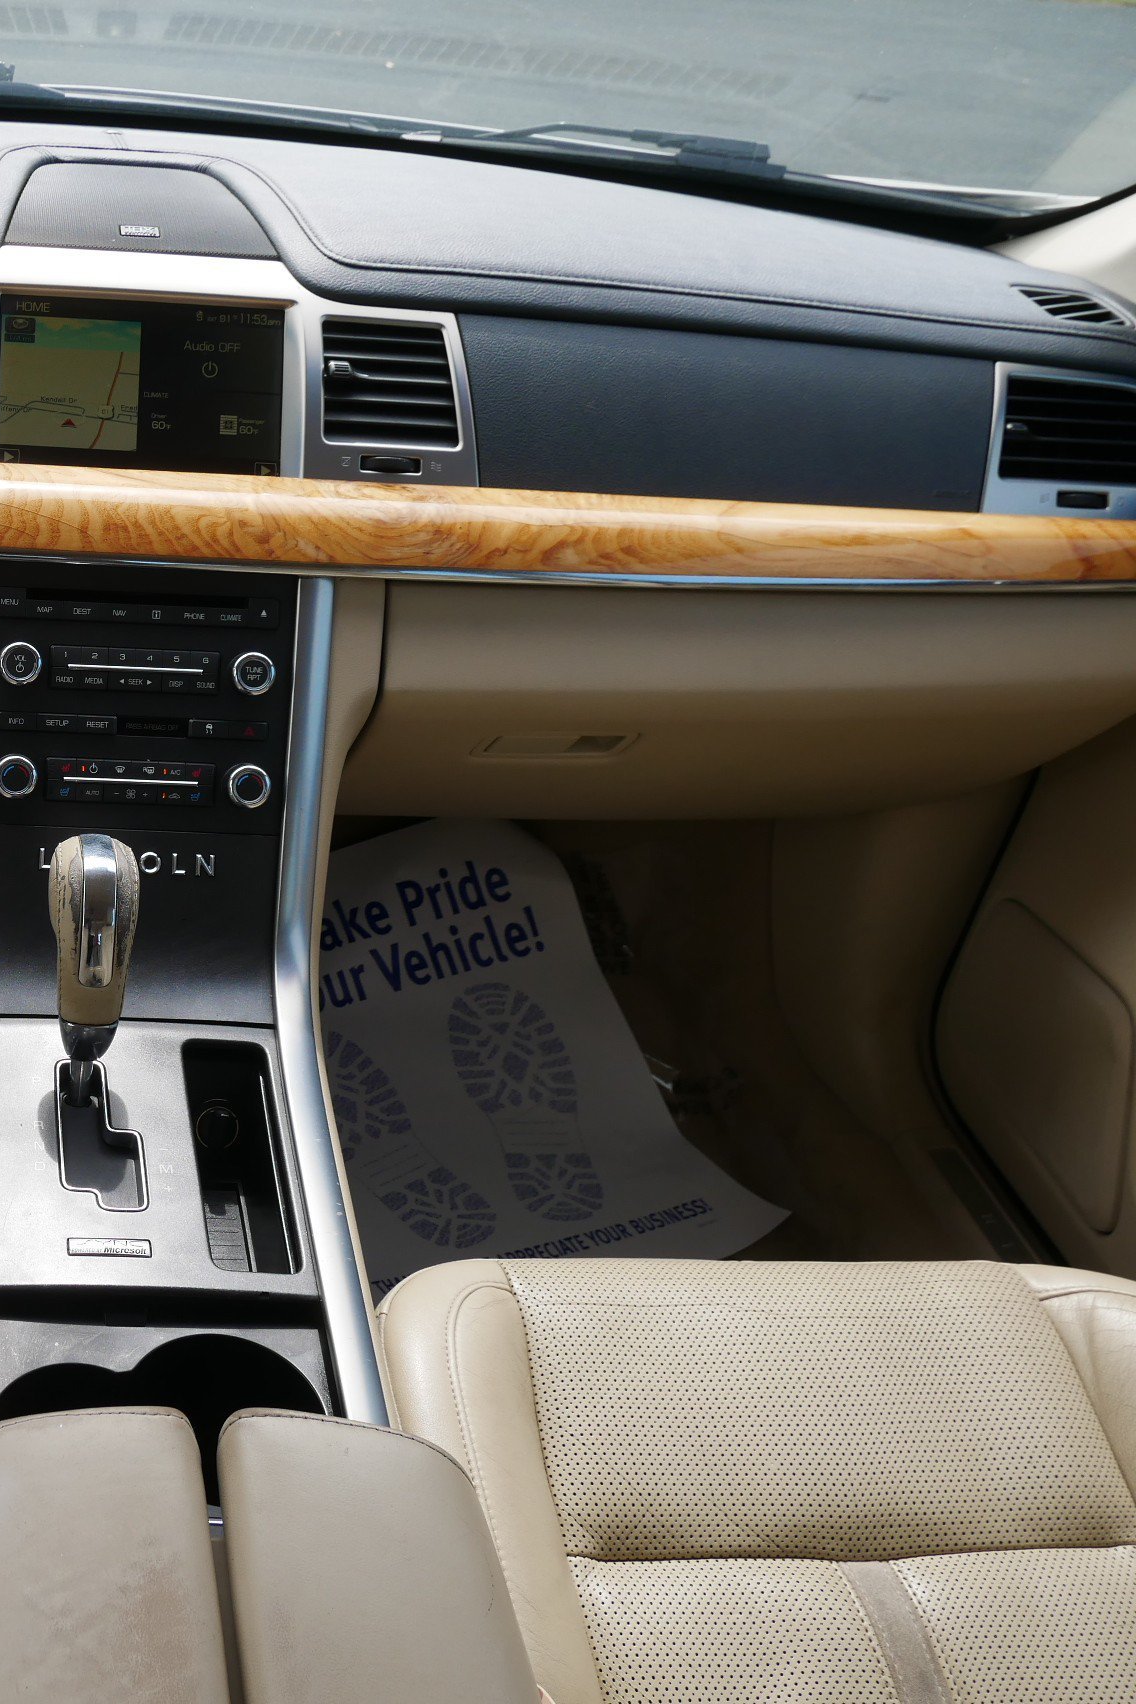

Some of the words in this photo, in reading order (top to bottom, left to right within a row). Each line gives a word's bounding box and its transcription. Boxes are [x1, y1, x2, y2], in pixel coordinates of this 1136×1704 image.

[16, 302, 51, 313] HOME
[184, 340, 215, 352] Audio
[218, 342, 241, 353] OFF
[143, 391, 169, 399] CLIMATE
[0, 598, 19, 606] MENU
[37, 606, 53, 614] MAP
[112, 609, 127, 617] NAV
[184, 612, 205, 621] PHONE
[220, 614, 242, 622] CLIMATE
[91, 652, 98, 660] 2
[119, 653, 126, 661] 3
[146, 654, 153, 662] 4
[173, 655, 180, 663] 5
[245, 666, 263, 674] TUNE
[56, 676, 74, 684] RADIO
[84, 677, 103, 685] MEDIA
[128, 678, 143, 686] SEEK
[169, 680, 183, 688] DISP
[196, 681, 215, 689] SOUND
[8, 717, 24, 725] INFO
[45, 719, 69, 727] SETUP
[86, 720, 109, 729] RESET
[39, 847, 215, 876] LOLN
[320, 899, 393, 952] ake
[396, 860, 512, 927] Pride
[369, 905, 545, 992] Vehicle!
[33, 1121, 45, 1130] R
[34, 1162, 46, 1171] D
[158, 1165, 174, 1174] M
[586, 1219, 633, 1248] YOUR
[628, 1197, 714, 1236] BUSINESS!
